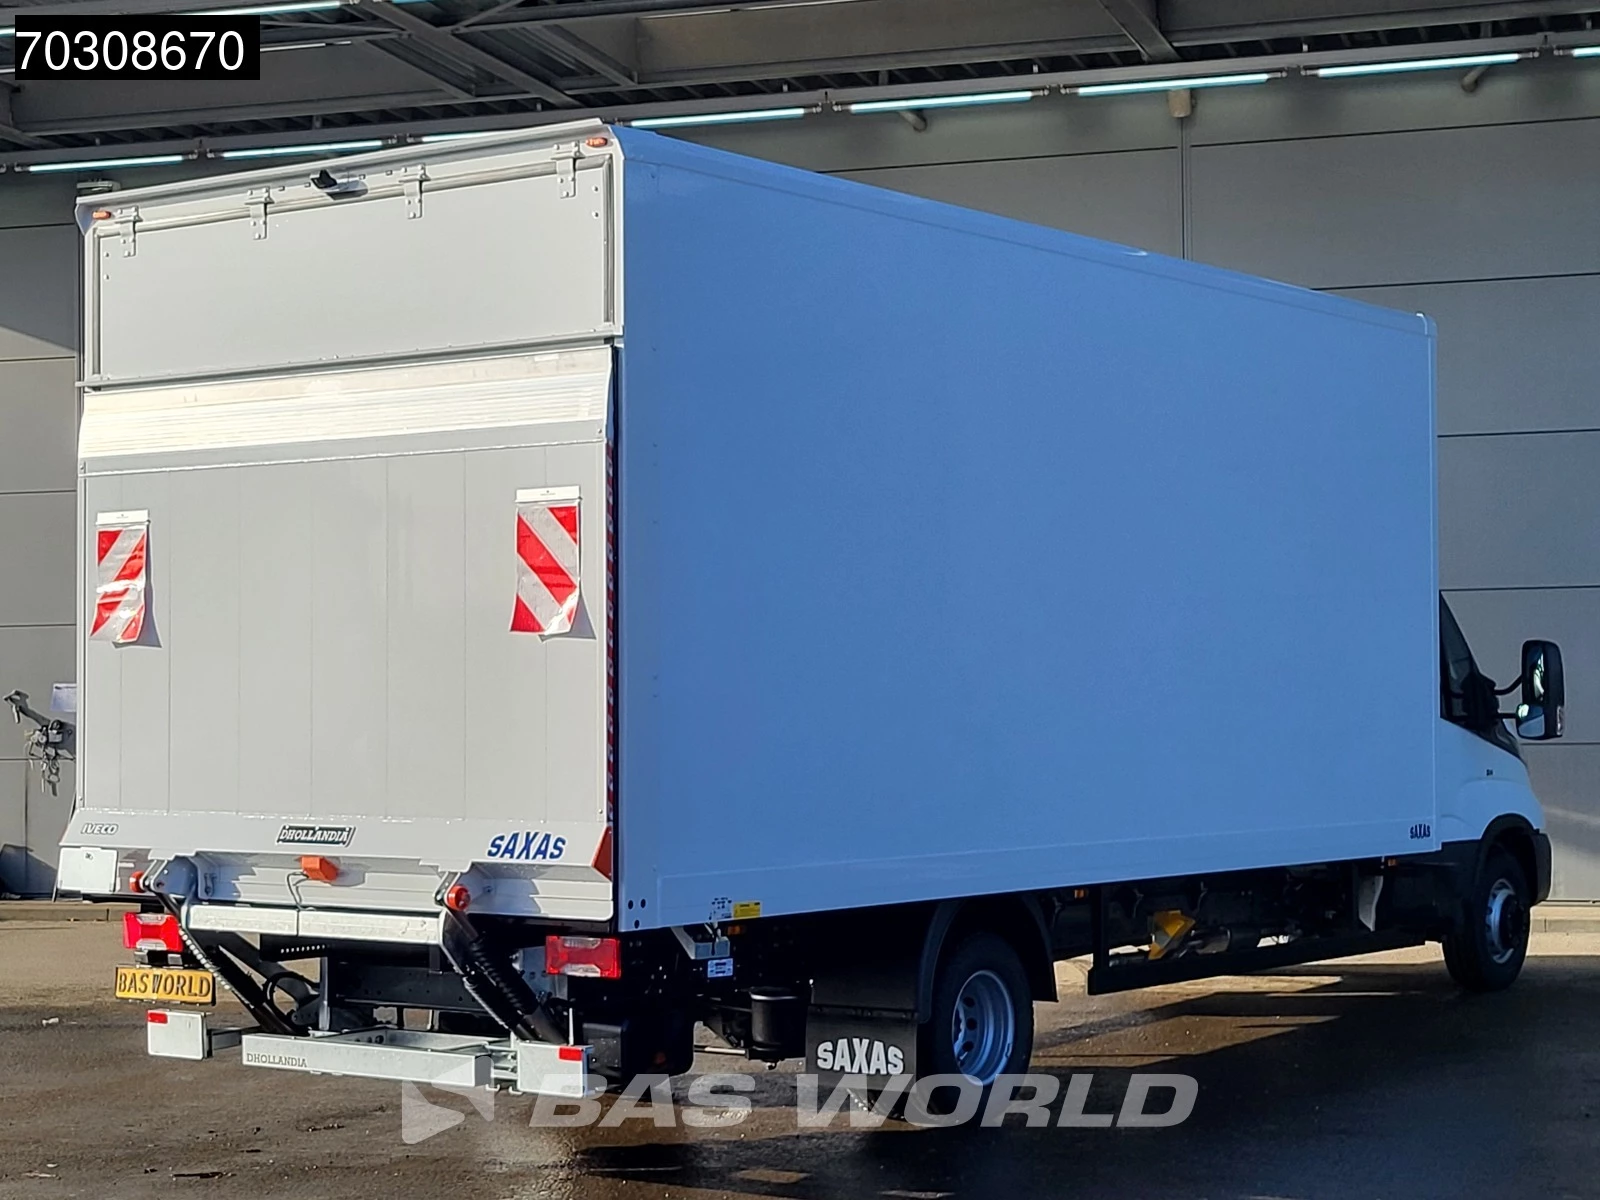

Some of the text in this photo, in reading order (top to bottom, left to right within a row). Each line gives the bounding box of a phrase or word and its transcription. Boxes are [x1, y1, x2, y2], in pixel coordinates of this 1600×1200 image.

[82, 823, 117, 836] IVECO
[279, 825, 350, 845] DHOLLANDIA
[1409, 823, 1431, 840] SAXAS
[487, 831, 566, 861] SAXAS
[118, 971, 212, 999] BAS WORLD
[245, 1052, 308, 1069] DHOLLANDIA
[816, 1037, 906, 1075] SAXAS
